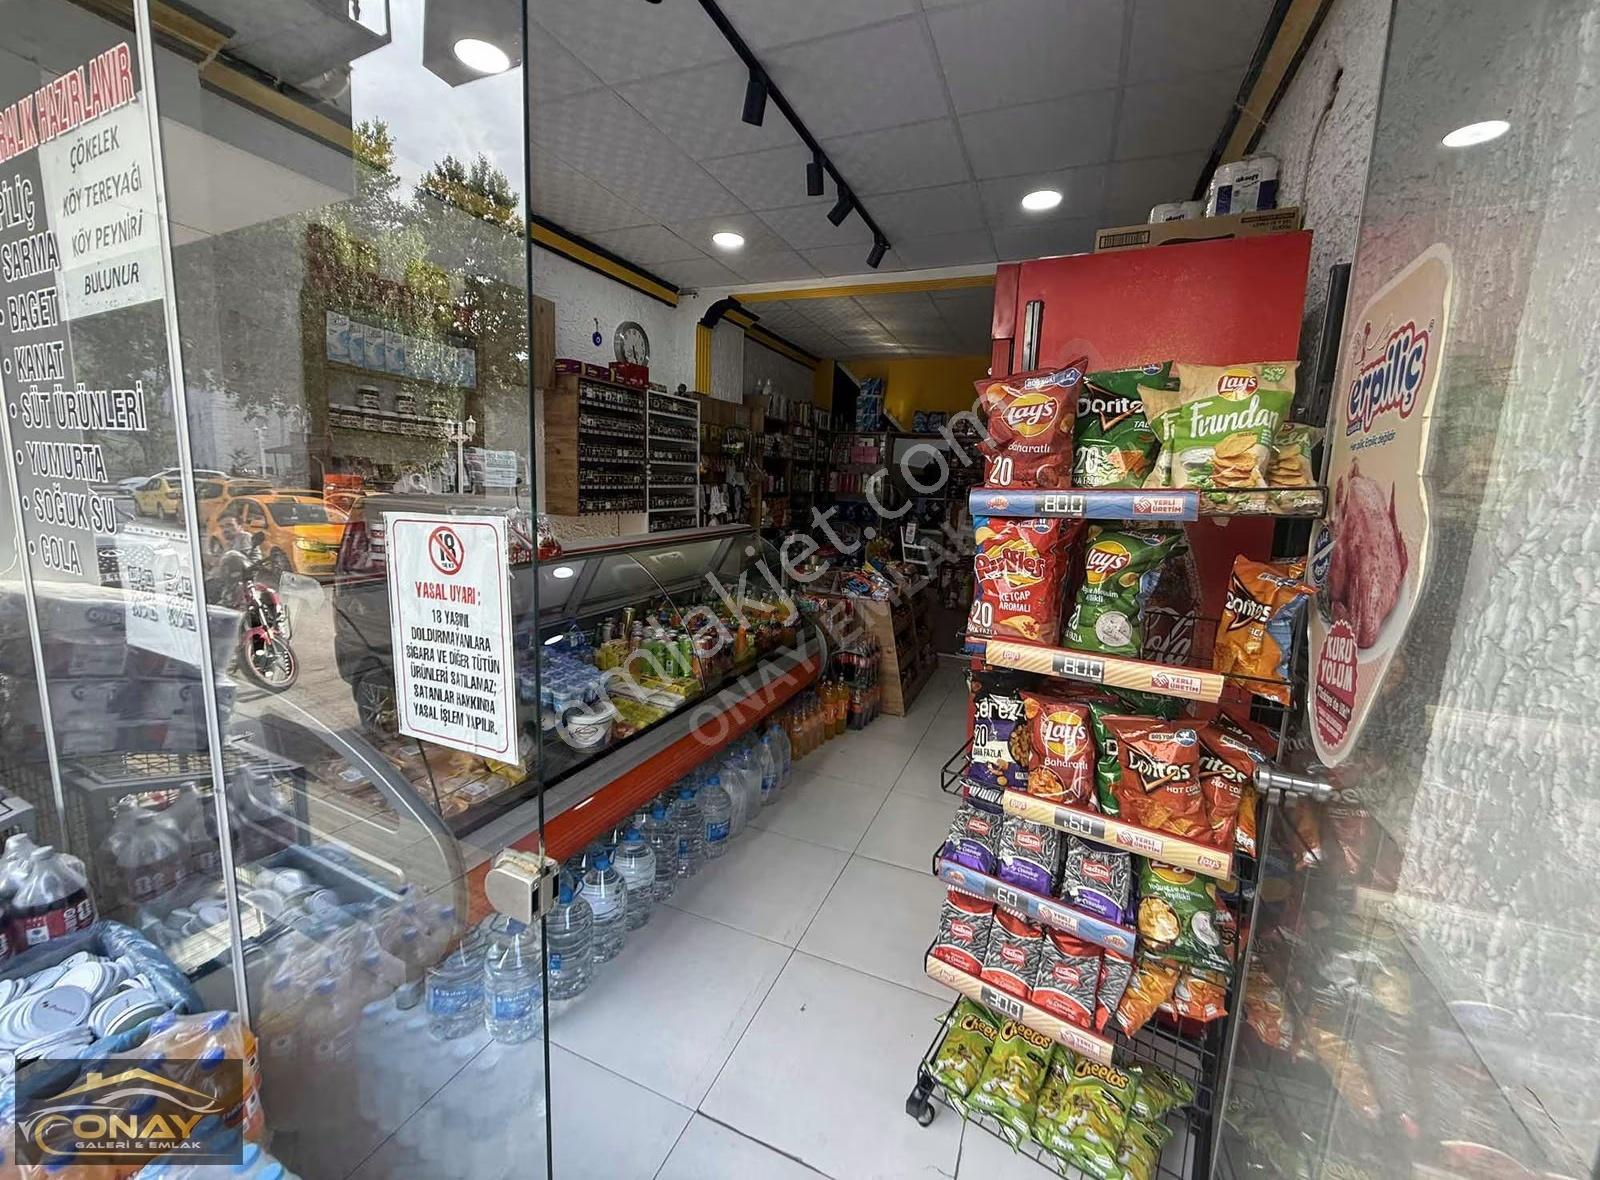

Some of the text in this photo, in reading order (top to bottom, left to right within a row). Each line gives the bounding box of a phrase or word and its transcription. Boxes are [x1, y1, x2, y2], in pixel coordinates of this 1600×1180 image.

[35, 41, 136, 145] HAZIRLANIR
[70, 125, 120, 174] ÇÖKELEK
[63, 163, 142, 217] KÖY TEREYAĞI
[72, 209, 143, 258] KÖY PEYNİRİ
[2, 230, 62, 283] SARMA
[84, 262, 140, 296] BULUNUR
[8, 286, 58, 333] BAGET
[14, 340, 65, 383] KANAT
[1348, 330, 1425, 430] erpiliç
[21, 380, 148, 431] SÜT ÜRÜNLERİ
[1077, 394, 1143, 418] Dorito
[25, 441, 109, 483] YUMURTA
[990, 455, 1013, 486] 20
[34, 482, 117, 535] SOĞUK SU
[39, 534, 83, 576] COLA
[415, 581, 448, 601] YASAL
[999, 589, 1031, 602] KETÇAP
[431, 609, 442, 624] 18
[972, 600, 993, 627] 20
[999, 602, 1031, 613] AROMALI
[1226, 592, 1272, 623] Doritos
[411, 626, 491, 652] DOLDURMAYANLARA
[1326, 635, 1353, 664] KURU
[406, 641, 435, 663] SİGARA
[437, 648, 448, 664] VE
[471, 653, 500, 675] TÜTÜN
[1321, 659, 1353, 693] YOLUM
[413, 702, 439, 721] YASAL
[974, 724, 988, 747] 20
[1128, 750, 1191, 781] Doritos
[1200, 755, 1247, 783] ritos
[1167, 785, 1184, 793] HOT
[961, 1014, 997, 1041] Cheet
[1001, 1019, 1052, 1049] Cheetos
[1074, 1059, 1129, 1089] Cheetos
